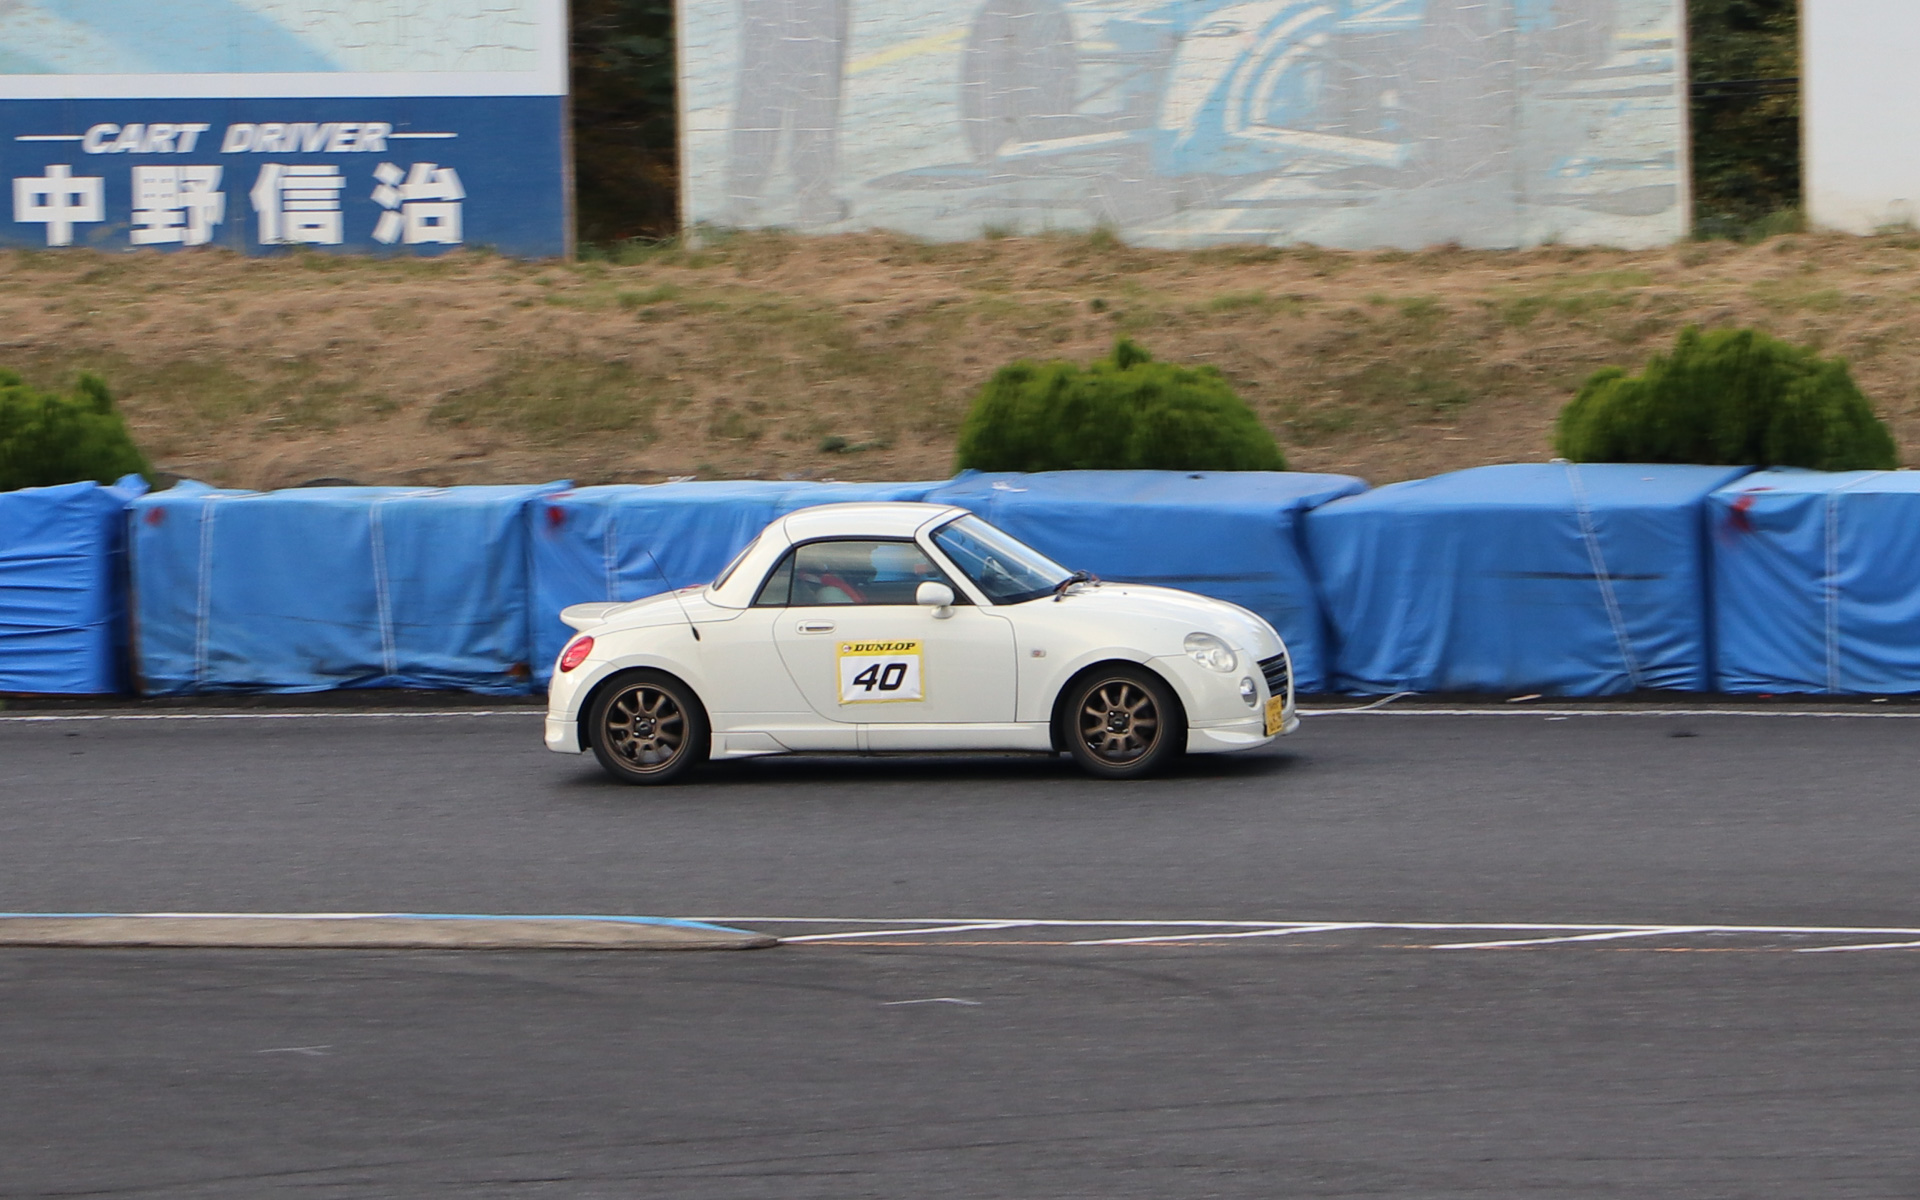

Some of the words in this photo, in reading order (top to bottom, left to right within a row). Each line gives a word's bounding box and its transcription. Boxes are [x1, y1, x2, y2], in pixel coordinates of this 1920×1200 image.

[82, 123, 211, 154] CART
[220, 122, 393, 153] DRIVER
[12, 162, 468, 247] 中野信治
[854, 642, 916, 652] DUNLOP
[852, 663, 908, 692] 40
